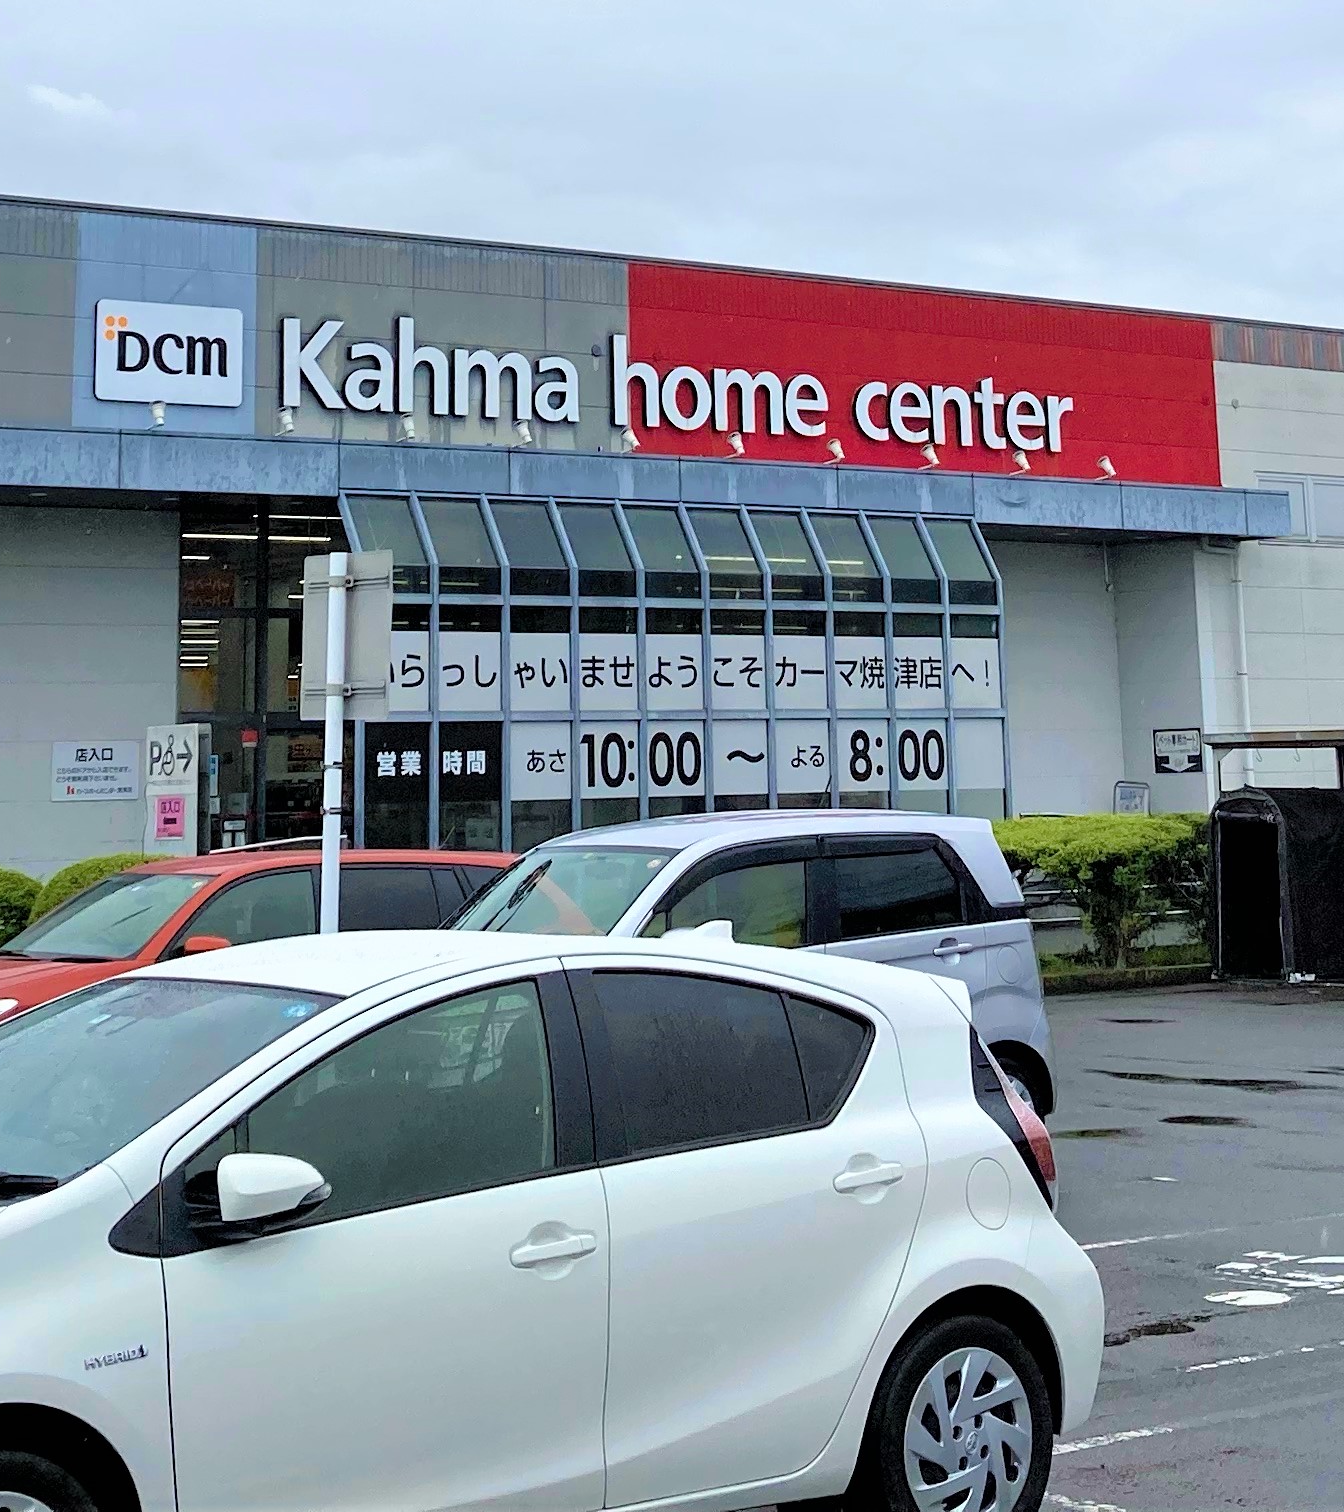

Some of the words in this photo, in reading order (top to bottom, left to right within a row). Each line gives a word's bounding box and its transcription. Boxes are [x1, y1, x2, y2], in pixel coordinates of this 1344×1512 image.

[281, 316, 580, 423] Kahma
[611, 334, 829, 437] home
[854, 376, 1074, 453] center
[389, 653, 990, 690] らっしゃいませようこそカーマ焼津店へ！
[75, 747, 113, 763] 店入口
[526, 748, 567, 774] あさ
[580, 731, 702, 788] 10:00
[790, 745, 825, 768] よる
[849, 728, 945, 782] 8:00
